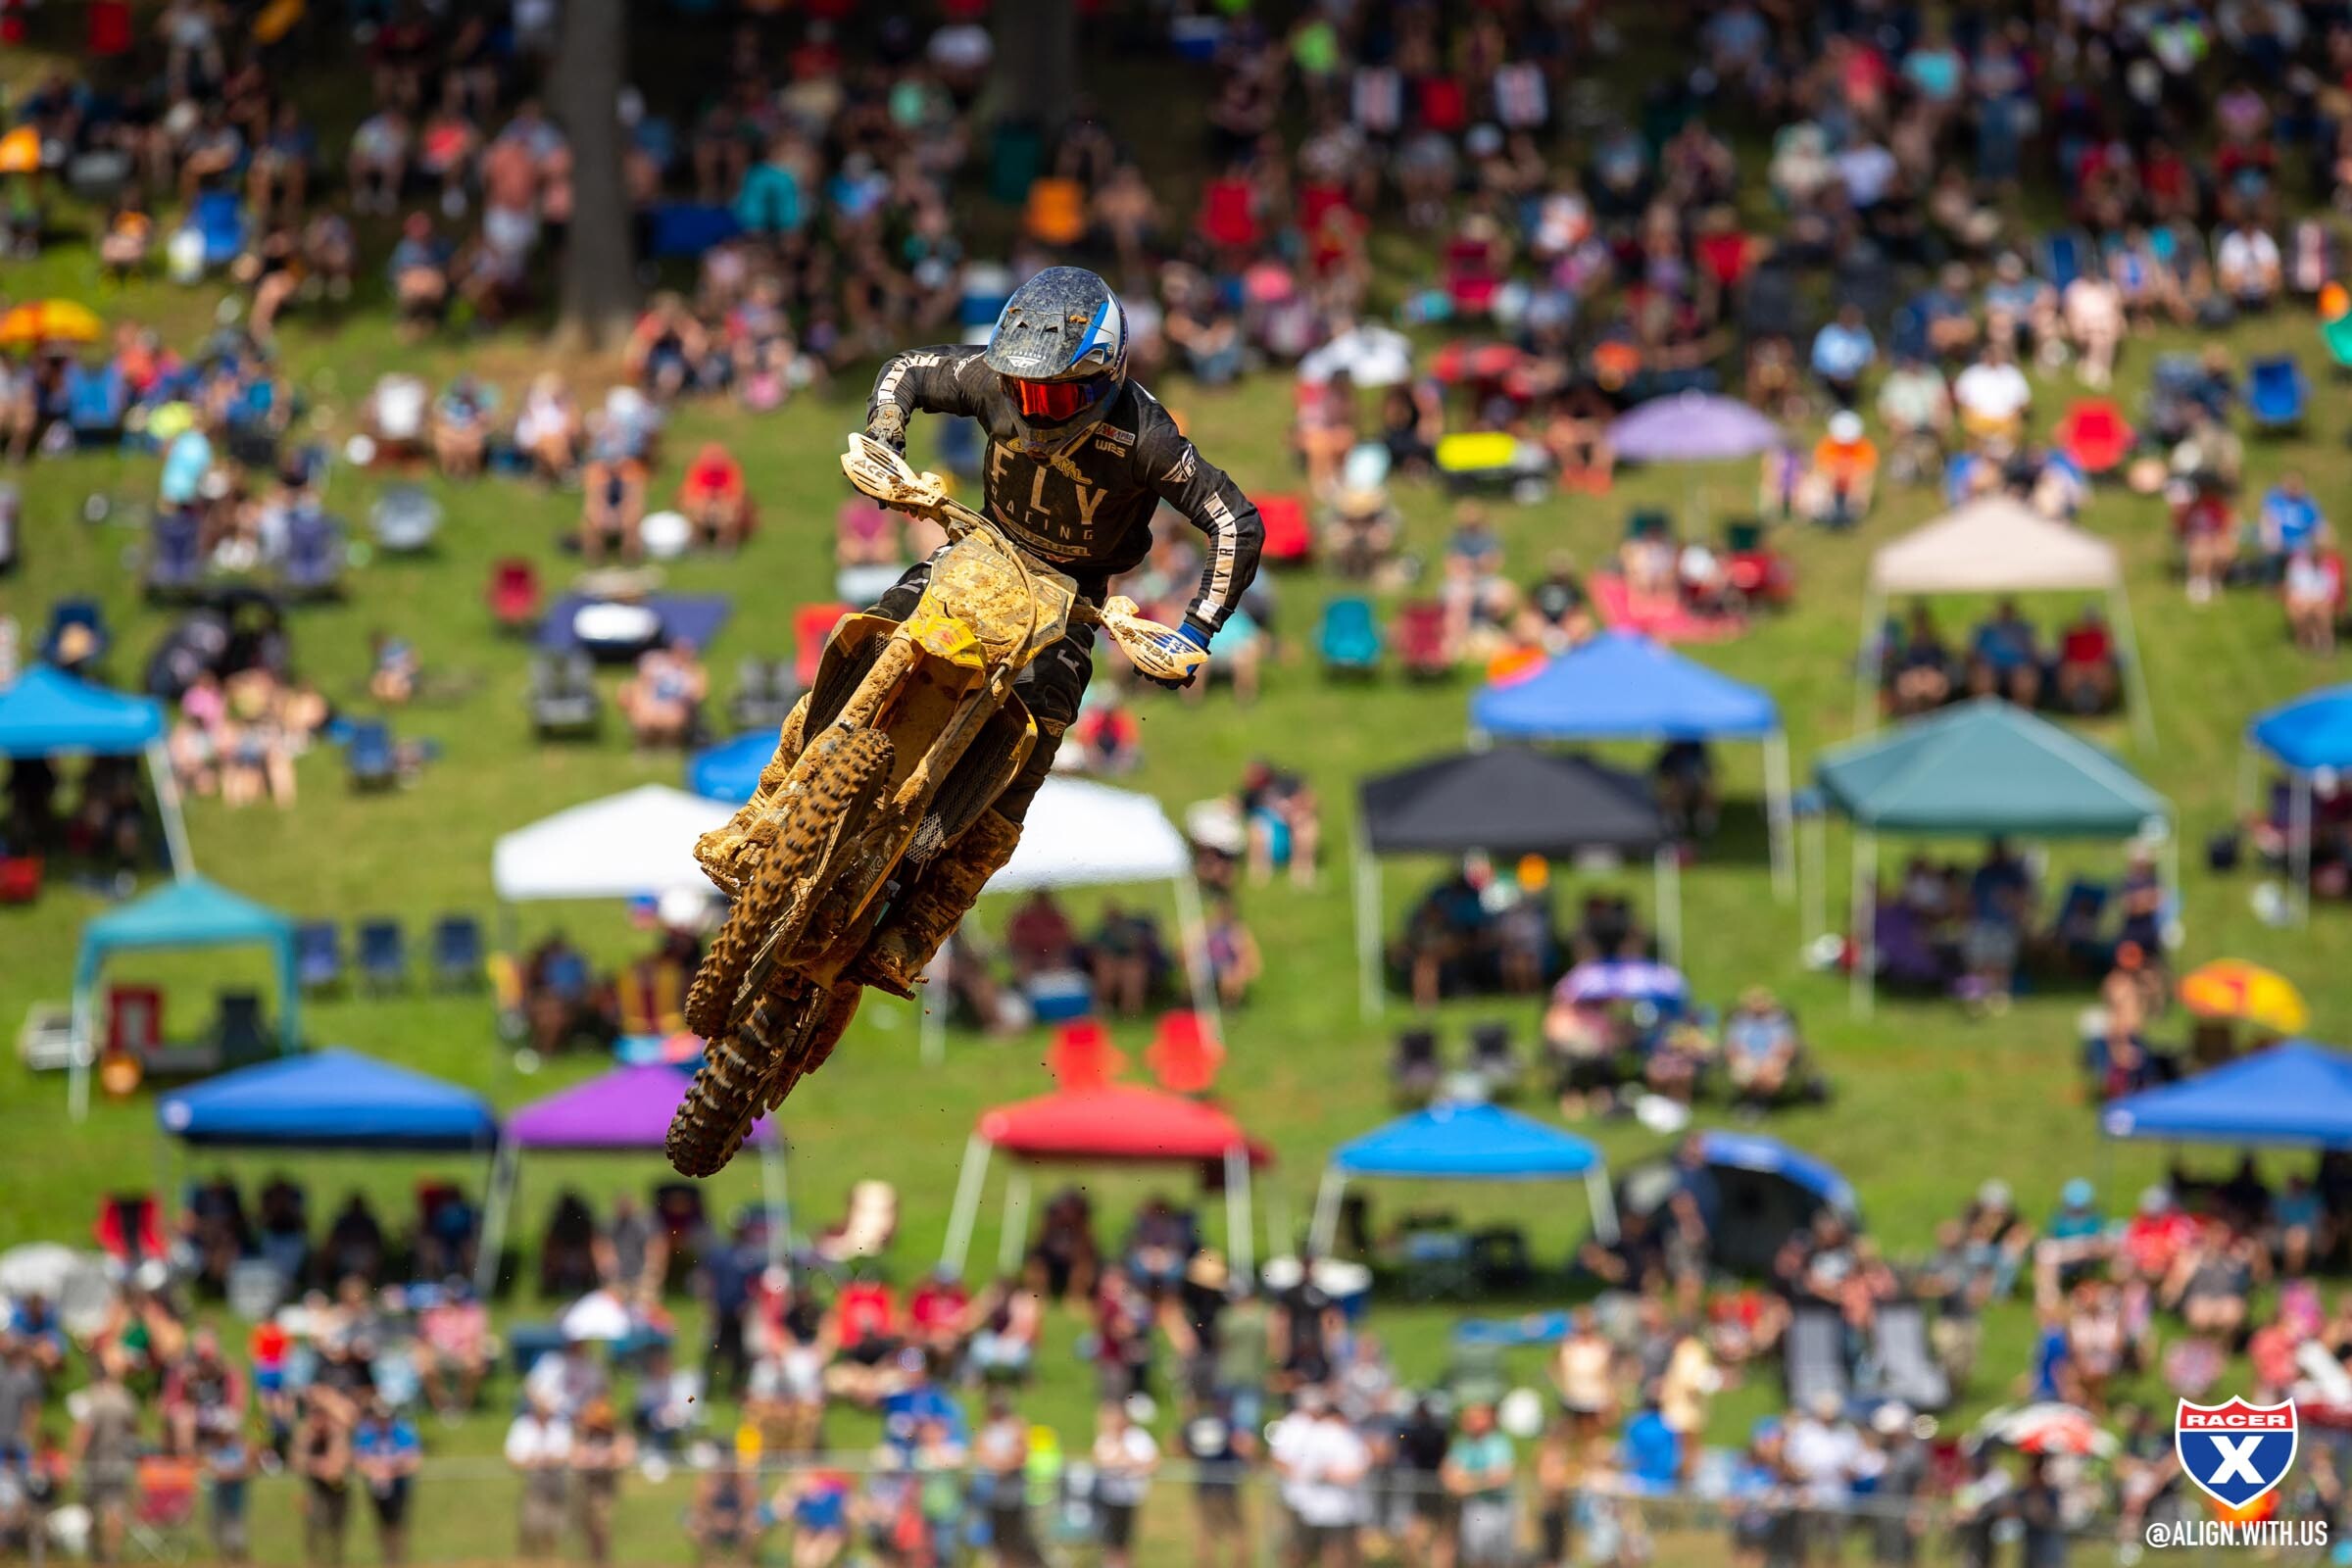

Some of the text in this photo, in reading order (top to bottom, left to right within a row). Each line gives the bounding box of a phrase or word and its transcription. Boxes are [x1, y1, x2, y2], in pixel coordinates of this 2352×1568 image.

[1096, 439, 1126, 458] WPS
[991, 441, 1108, 525] FLY
[991, 484, 1094, 541] RACING
